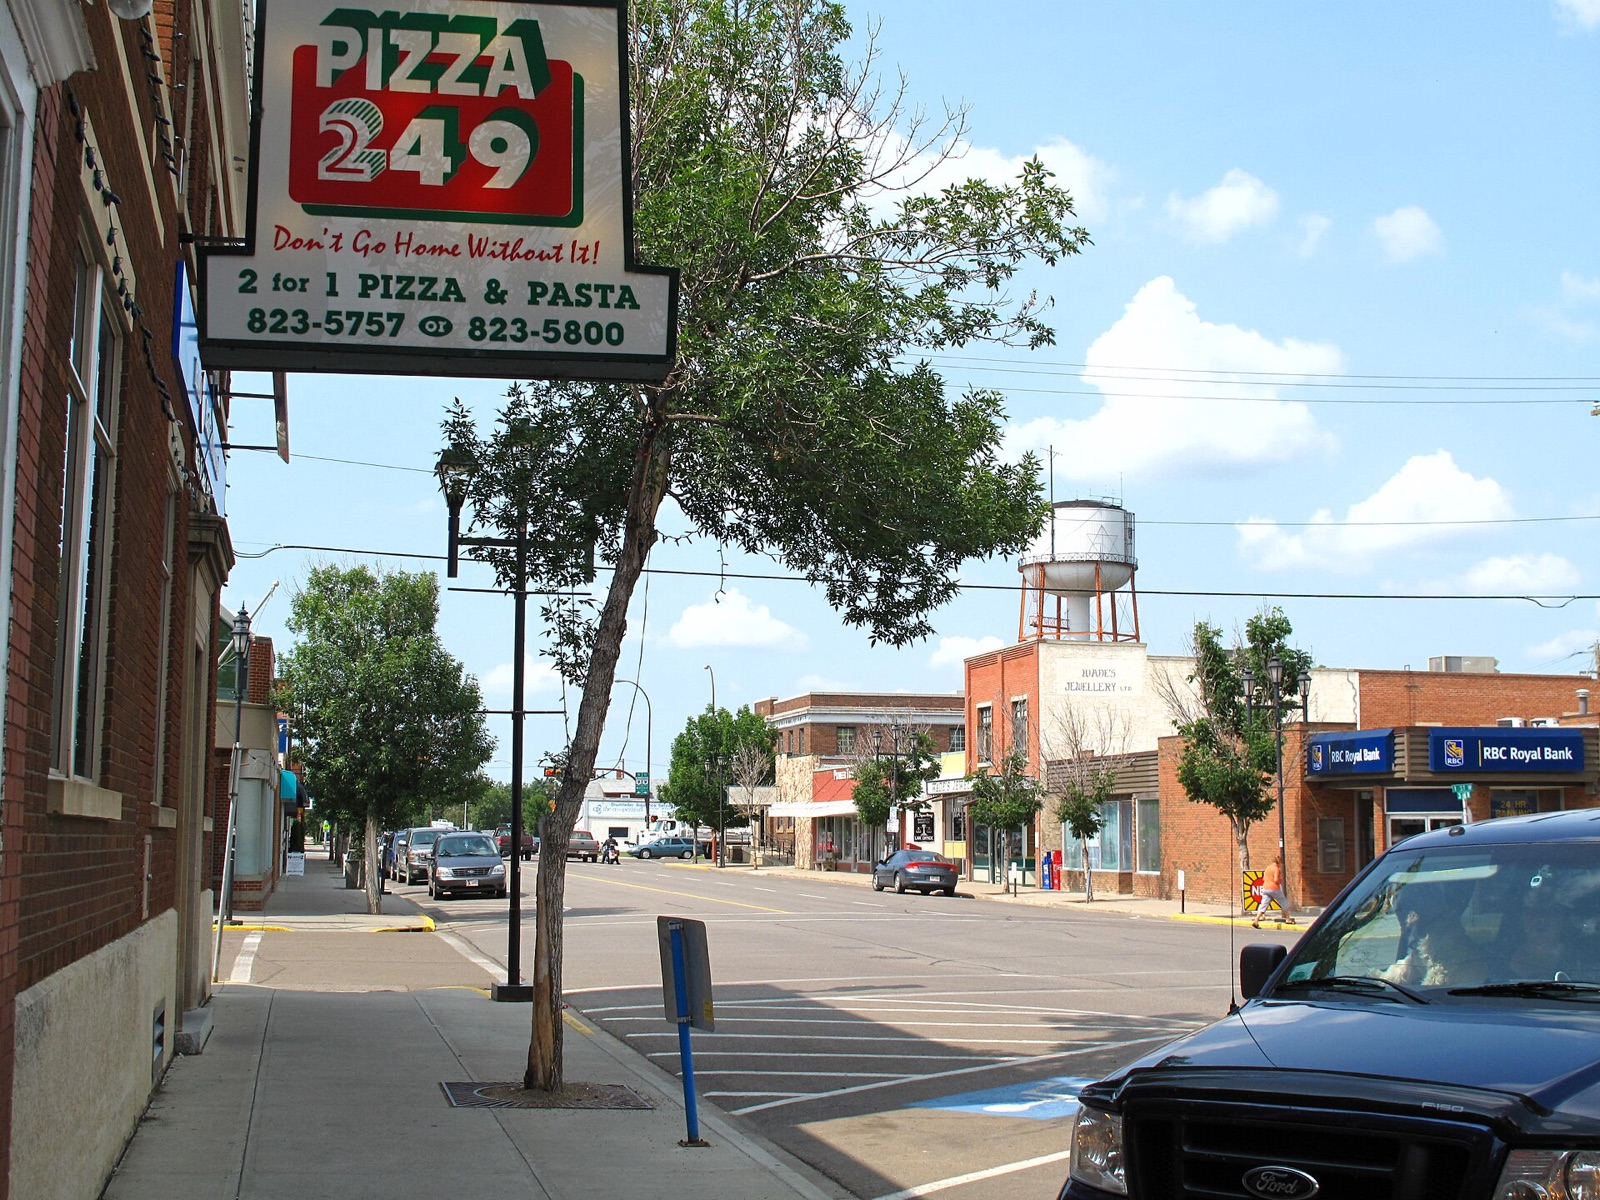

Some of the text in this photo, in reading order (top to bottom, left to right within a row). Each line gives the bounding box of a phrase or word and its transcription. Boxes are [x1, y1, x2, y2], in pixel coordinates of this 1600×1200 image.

[316, 15, 546, 100] PIZZA
[318, 97, 539, 190] 249
[273, 225, 600, 266] Don't Go Home Without It!
[237, 269, 640, 310] 2 for 1 PIZZA & PASTA
[247, 307, 625, 346] 823-5757 or 823-5800
[1082, 669, 1116, 678] WADE'S
[1065, 682, 1116, 692] JEWELLERY
[1331, 747, 1380, 765] RBC Royal Bank
[1483, 747, 1573, 763] RBC Royal Bank
[1501, 800, 1527, 808] 24 HR
[1251, 885, 1264, 896] NE
[1256, 1171, 1297, 1193] Ford
